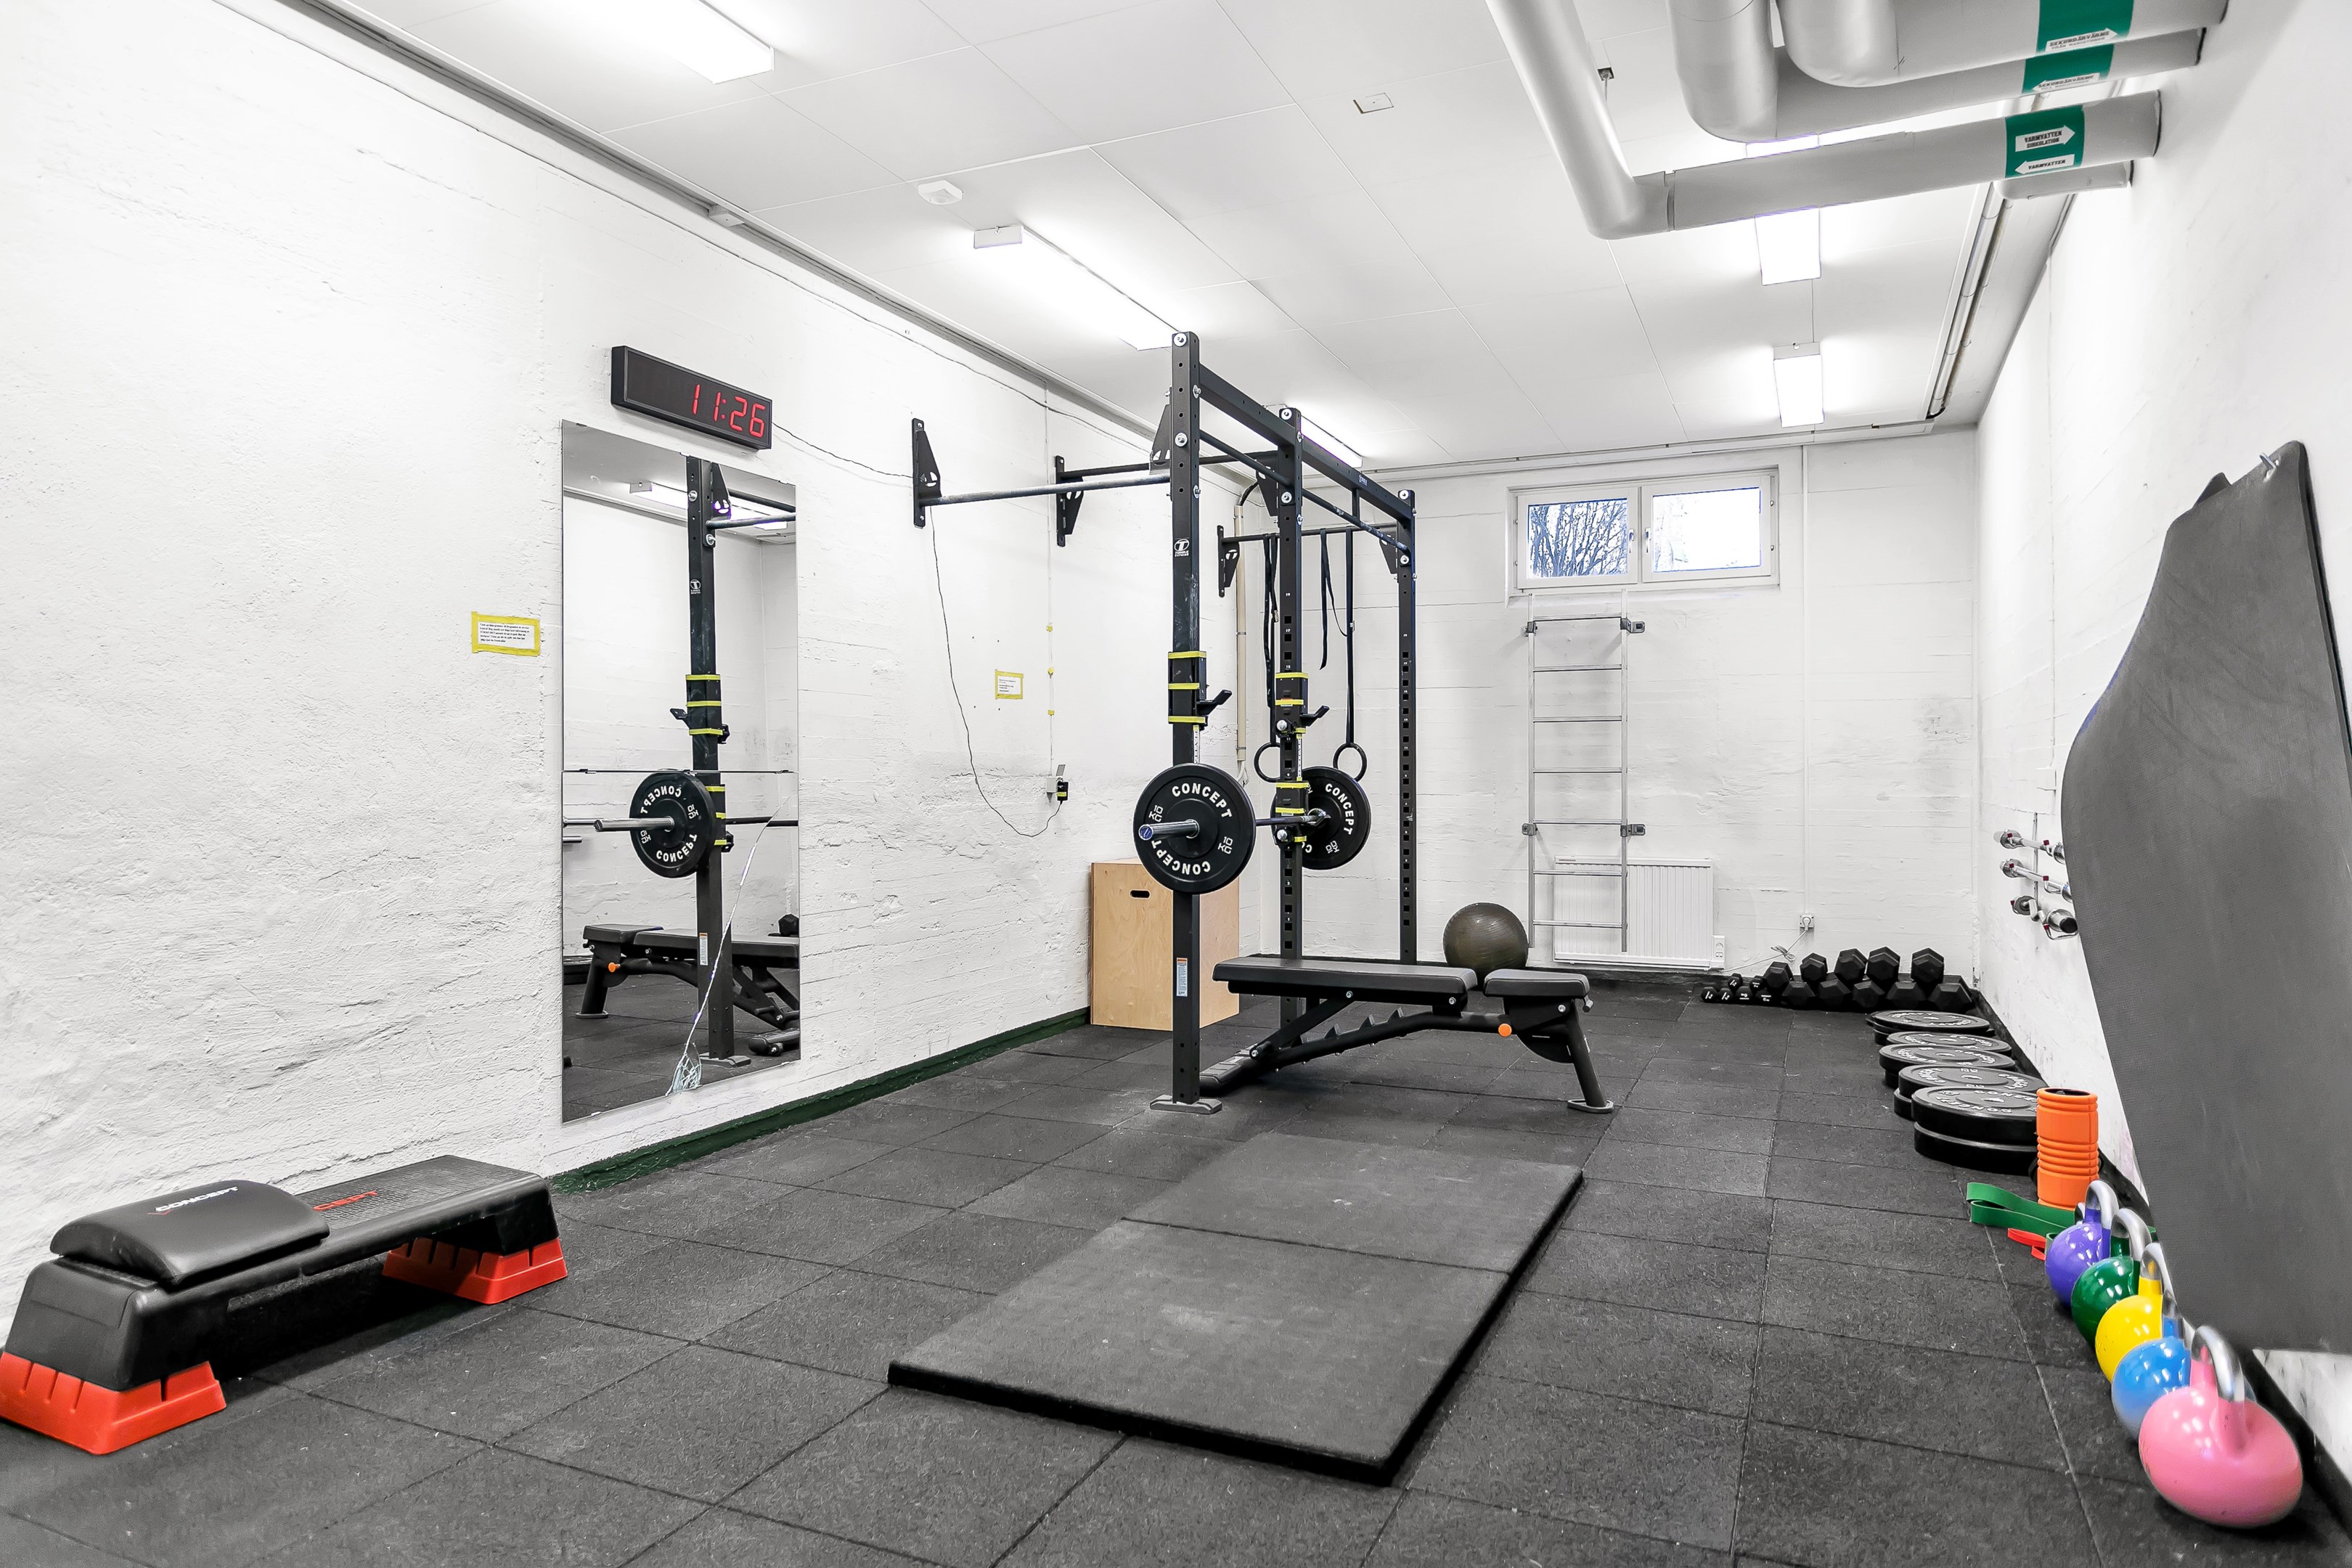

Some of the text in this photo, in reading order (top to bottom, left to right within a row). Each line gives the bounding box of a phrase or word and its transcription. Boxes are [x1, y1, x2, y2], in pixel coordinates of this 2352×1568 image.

[2024, 131, 2062, 143] VARMVATTEN
[2028, 160, 2066, 169] VARMVATTEN
[692, 384, 766, 438] 11:26
[1172, 783, 1233, 818] CONCEPT
[1148, 811, 1163, 822] KG
[1153, 805, 1164, 814] 10
[1325, 783, 1355, 835] CONCEPT
[1217, 843, 1233, 854] KG
[1222, 836, 1233, 846] 10
[1151, 840, 1211, 875] CONCEPT
[155, 1186, 238, 1212] CONCEPT
[313, 1191, 377, 1212] CEPT
